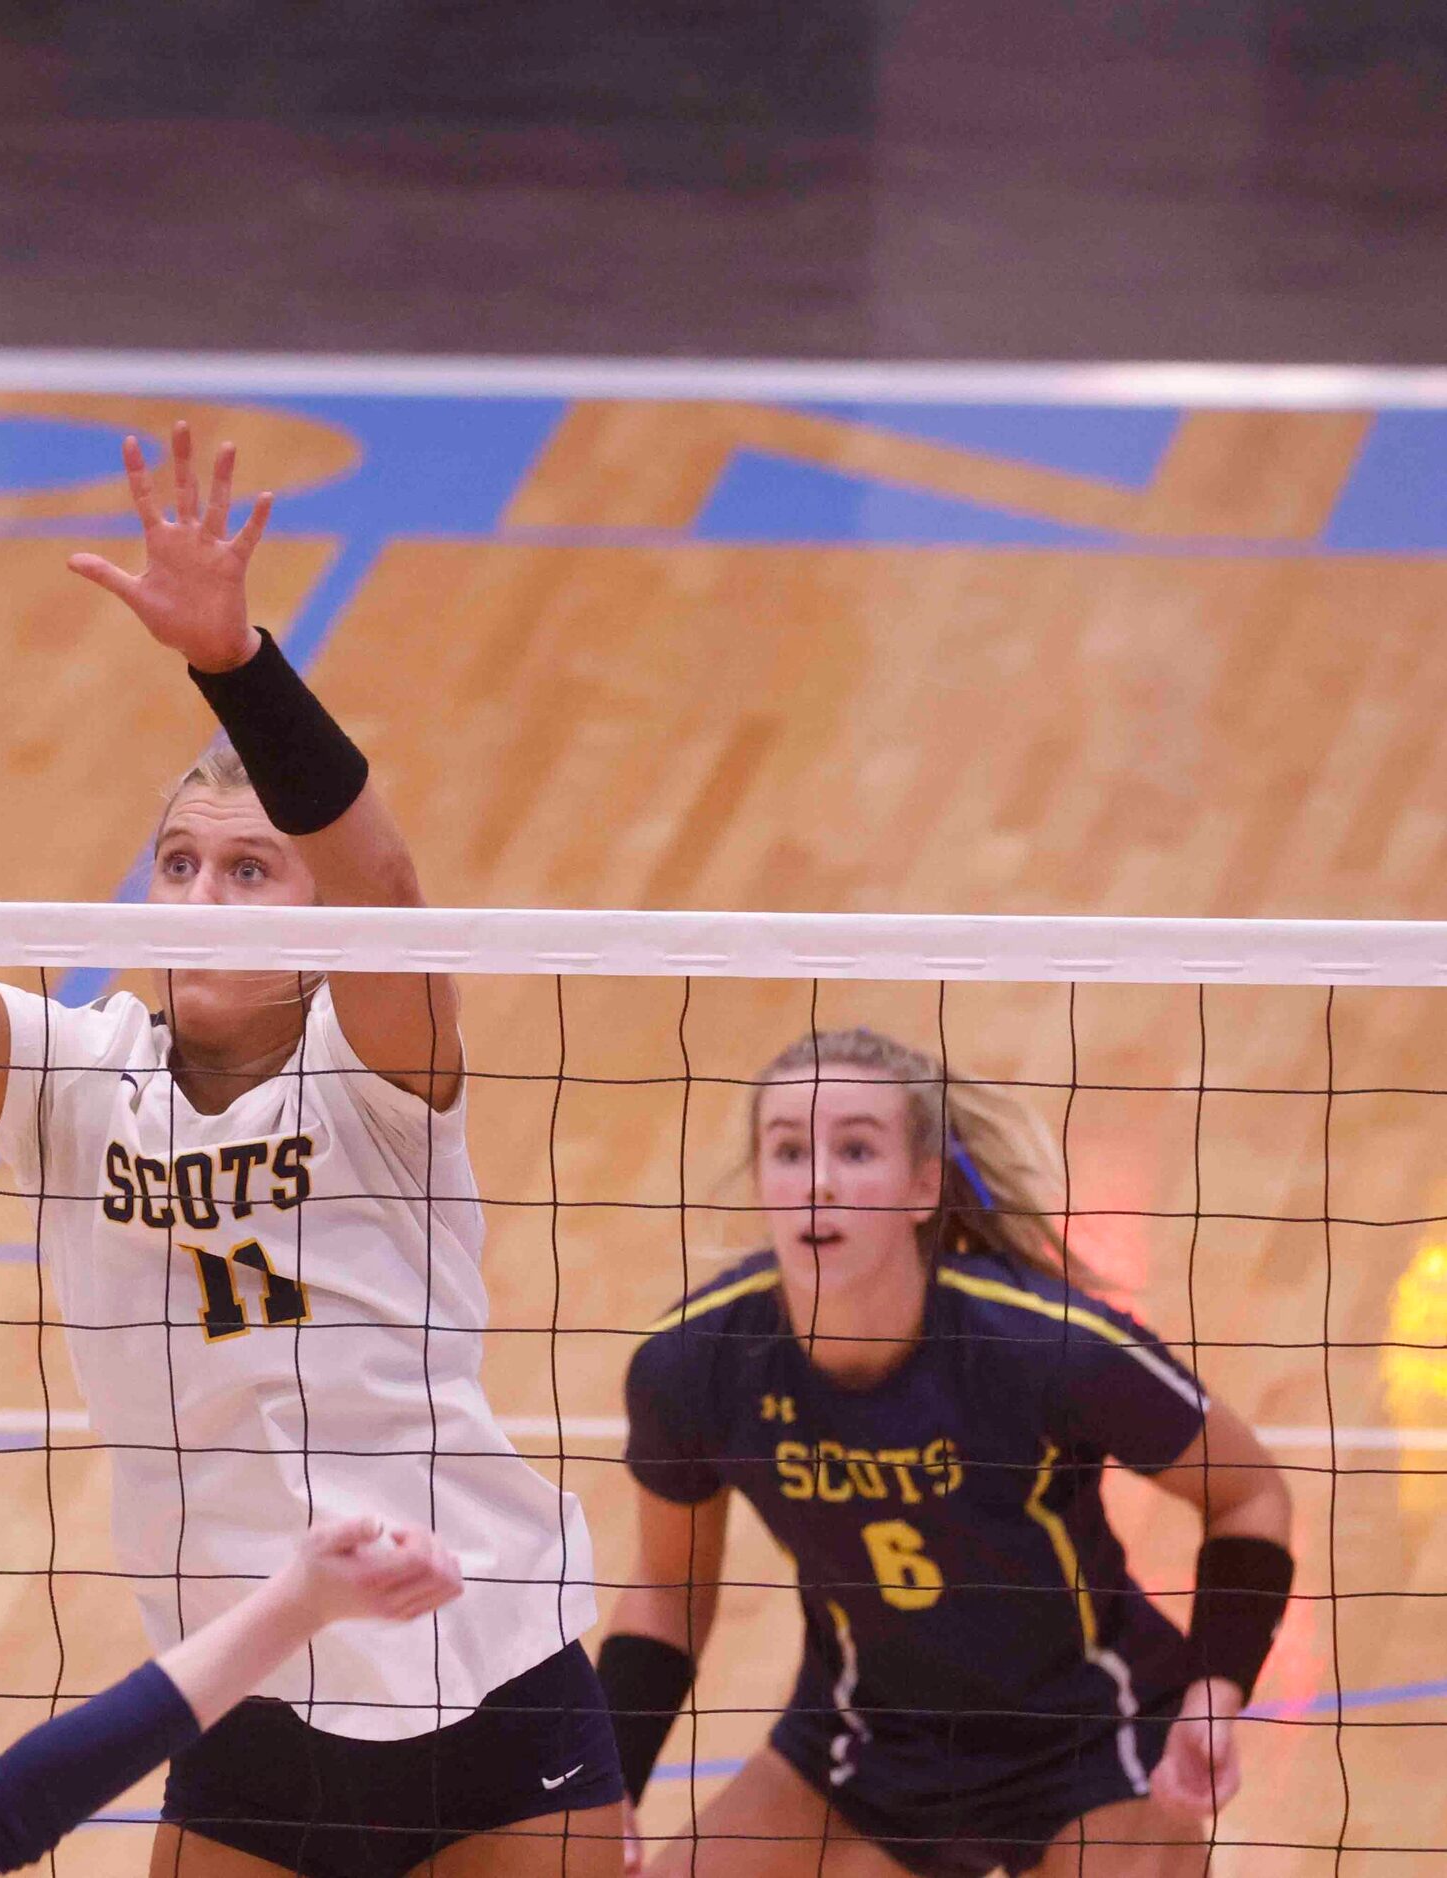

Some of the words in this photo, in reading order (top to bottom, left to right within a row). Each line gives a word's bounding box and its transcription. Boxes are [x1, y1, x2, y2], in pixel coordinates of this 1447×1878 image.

[103, 1135, 313, 1229] SCOTS
[176, 1237, 313, 1344] 11
[775, 1438, 964, 1504] SCOTS
[860, 1519, 944, 1611] 6
